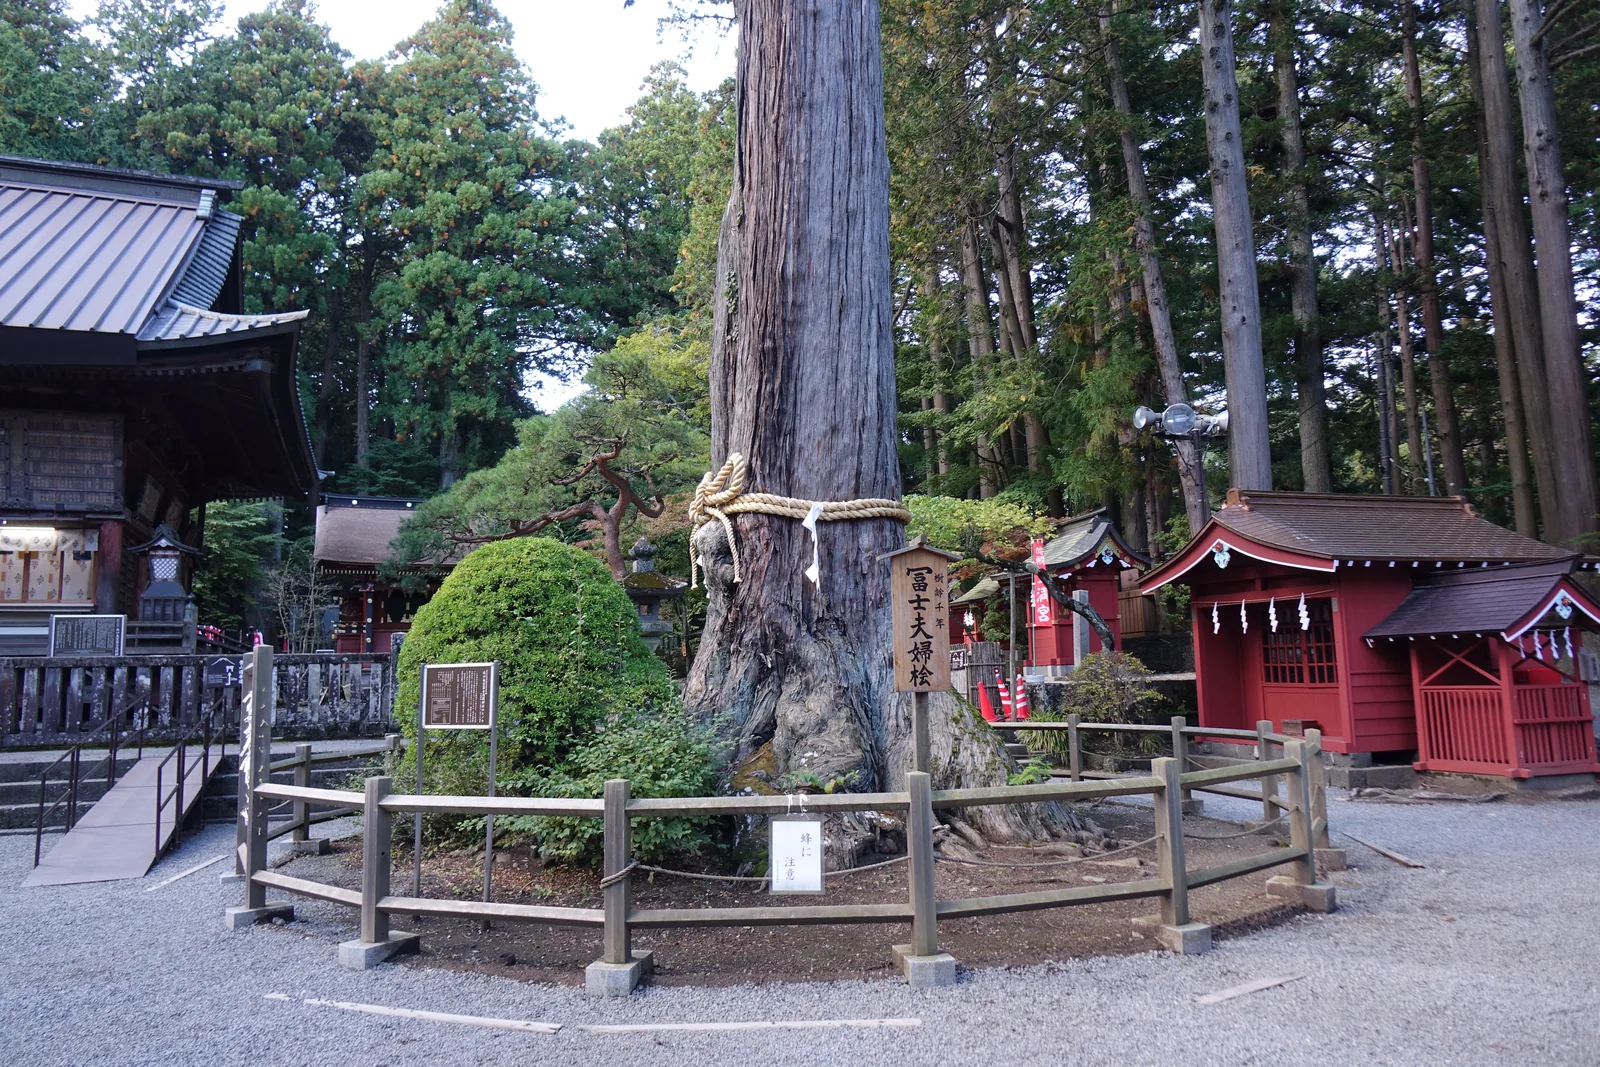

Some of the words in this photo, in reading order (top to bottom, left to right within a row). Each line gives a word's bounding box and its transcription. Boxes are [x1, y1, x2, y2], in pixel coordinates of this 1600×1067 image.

[934, 572, 945, 630] 樹齢千年
[800, 833, 812, 857] 蜂に
[784, 856, 796, 881] 注意
